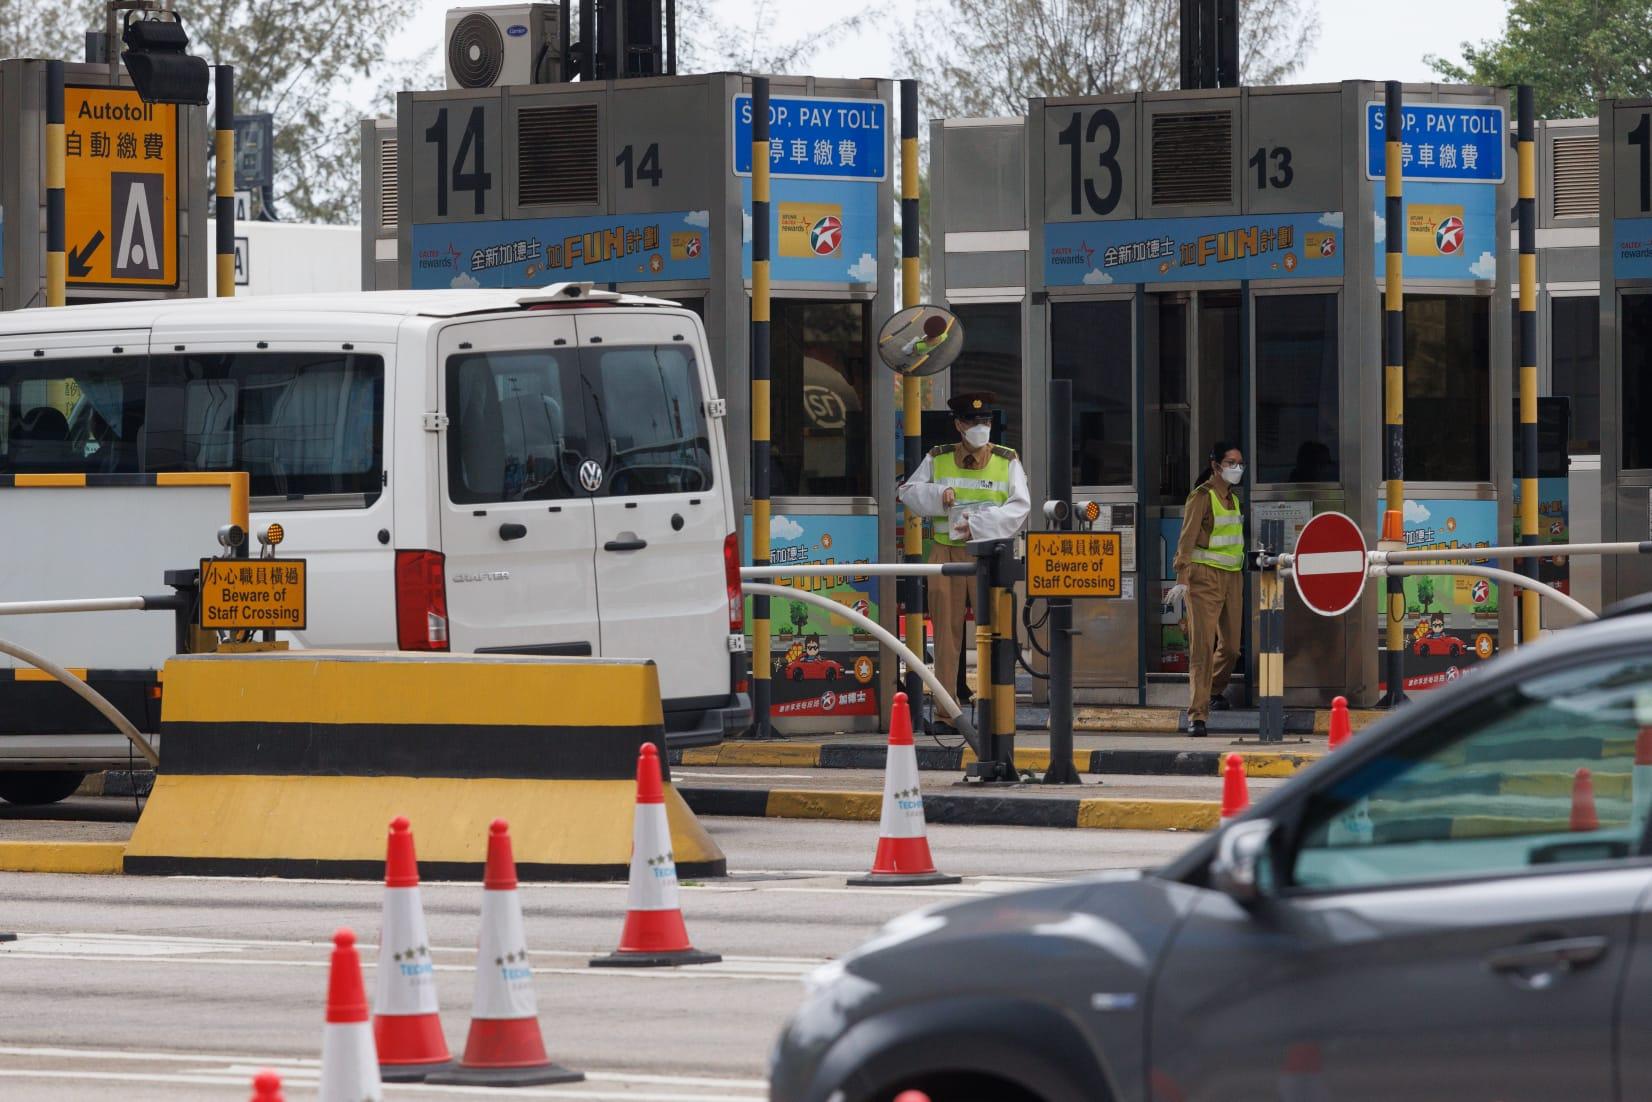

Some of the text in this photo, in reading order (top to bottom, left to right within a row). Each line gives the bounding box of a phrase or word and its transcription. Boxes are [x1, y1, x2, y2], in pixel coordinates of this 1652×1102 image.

[78, 100, 153, 122] Autotoll
[741, 104, 880, 130] SOP, PAY TOLL
[1373, 112, 1498, 135] SOP, PAY TOLL
[65, 130, 164, 161] 自動繳費
[768, 137, 858, 168] 停車繳費
[1400, 142, 1479, 171] 停車繳費
[425, 105, 492, 217] 14
[615, 142, 663, 189] 14
[1058, 108, 1123, 216] 13
[1248, 146, 1294, 190] 13
[419, 256, 452, 269] rewards
[471, 238, 541, 271] 全新加德士
[1051, 252, 1085, 265] rewards
[1103, 235, 1175, 268] 全新加德士
[1032, 538, 1115, 557] 小心職員橫過
[208, 567, 299, 585] 小心職員橫過
[1045, 558, 1104, 572] Beware of
[222, 588, 287, 602] Beware of
[1033, 575, 1060, 589] Staff
[1063, 575, 1115, 591] Crossing
[208, 605, 300, 622] Staff Crossing
